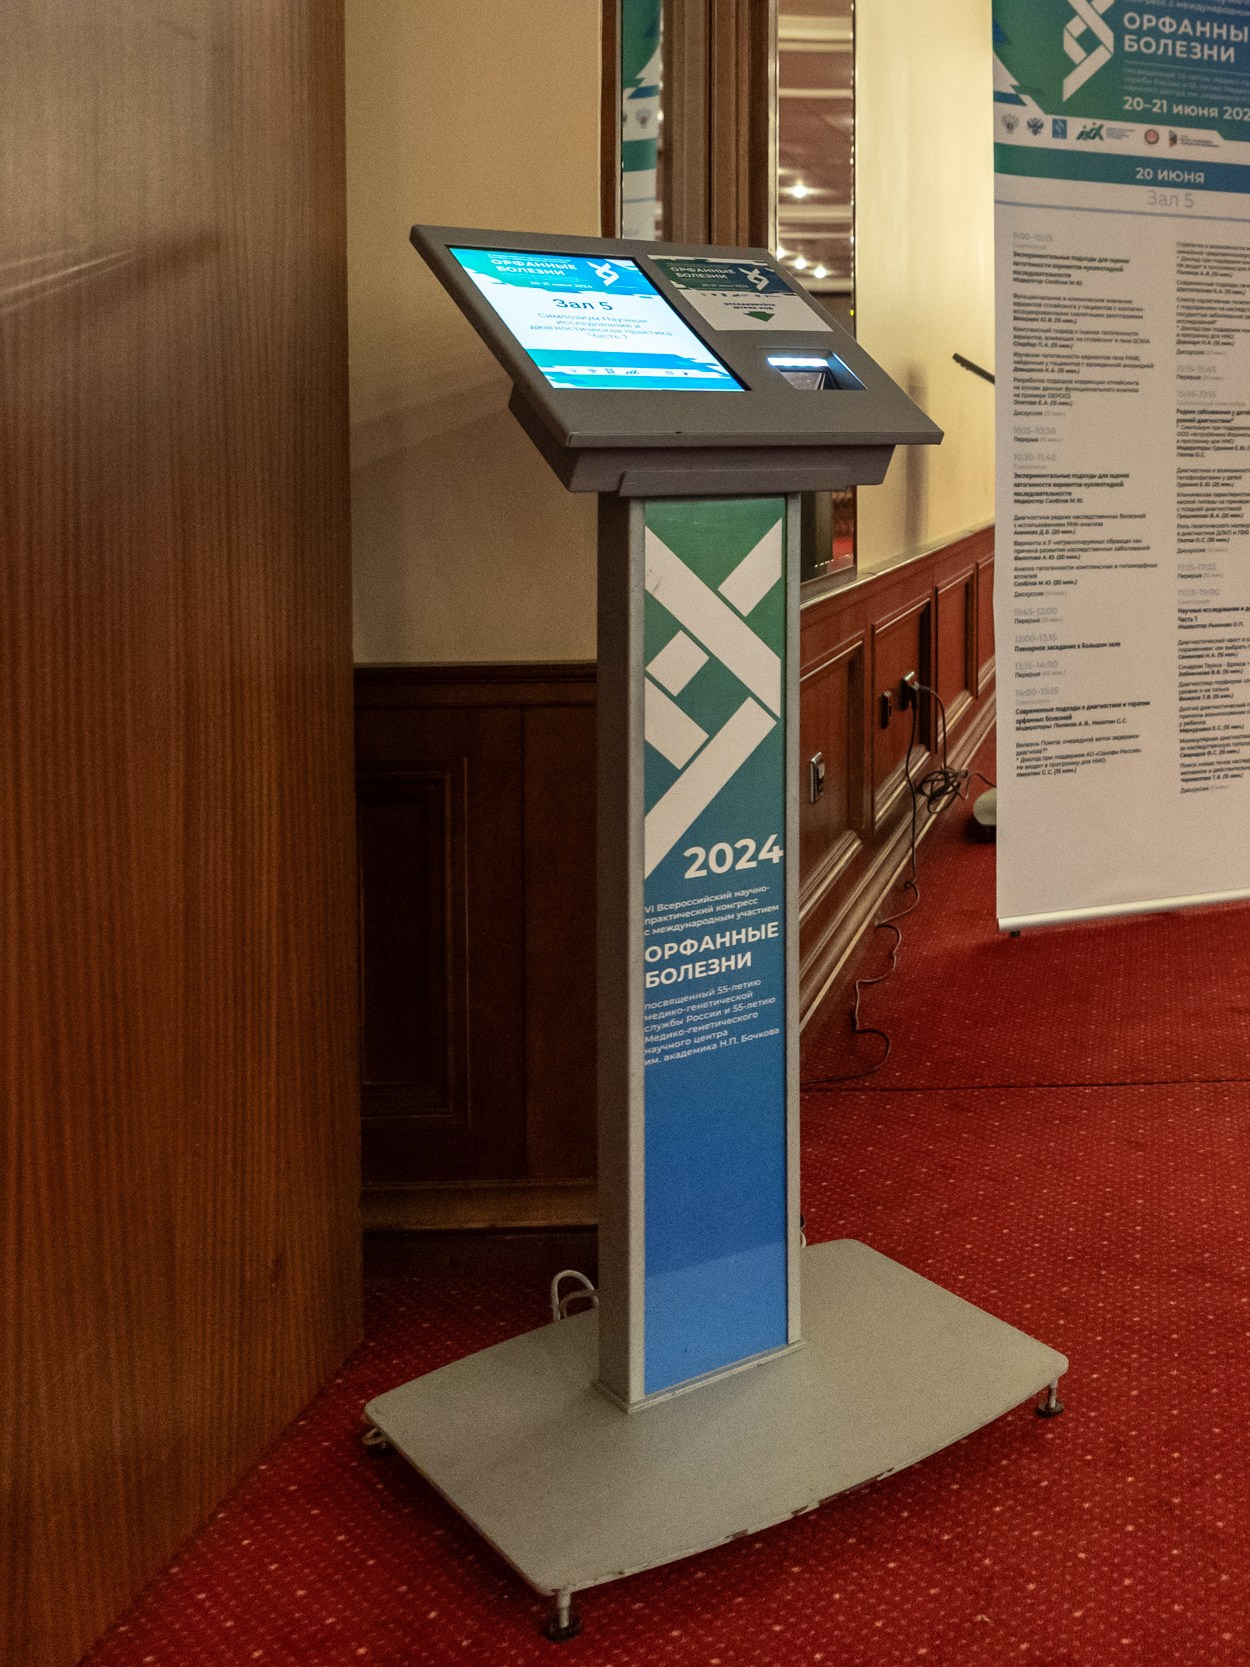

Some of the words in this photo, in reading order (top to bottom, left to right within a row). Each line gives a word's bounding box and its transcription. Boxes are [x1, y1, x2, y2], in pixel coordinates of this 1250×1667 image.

[1124, 34, 1236, 63] БОЛЕЗНИ
[1173, 104, 1218, 117] июня
[1136, 167, 1152, 180] 20
[1158, 169, 1204, 184] ИЮНЯ
[1148, 190, 1179, 208] Зал
[1184, 191, 1194, 208] 5
[491, 259, 577, 270] ОРФАННЫЕ
[497, 266, 565, 276] БОЛЕЗНИ
[538, 313, 600, 322] Симпозиум
[553, 299, 594, 309] Зал
[599, 302, 612, 310] 5
[683, 834, 784, 879] 2024
[645, 906, 713, 926] практический
[716, 898, 759, 914] конгресс
[657, 891, 732, 911] Всероссийский
[735, 885, 770, 899] научно-
[653, 912, 734, 936] международным
[736, 904, 779, 920] участием
[645, 922, 779, 963] ОРФАННЫЕ
[646, 952, 752, 988] БОЛЕЗНИ
[645, 989, 715, 1011] посвященный
[718, 978, 761, 995] 55-летию
[645, 991, 753, 1021] медико-генетической
[645, 1019, 683, 1033] службы
[687, 1010, 721, 1024] России
[733, 996, 776, 1013] 55-летию
[645, 1012, 759, 1043] Медико-генетического
[645, 1038, 692, 1056] научного
[694, 1029, 728, 1044] центра
[664, 1043, 717, 1062] академика
[720, 1037, 738, 1048] Н.П.
[741, 1027, 779, 1043] Бочкова
